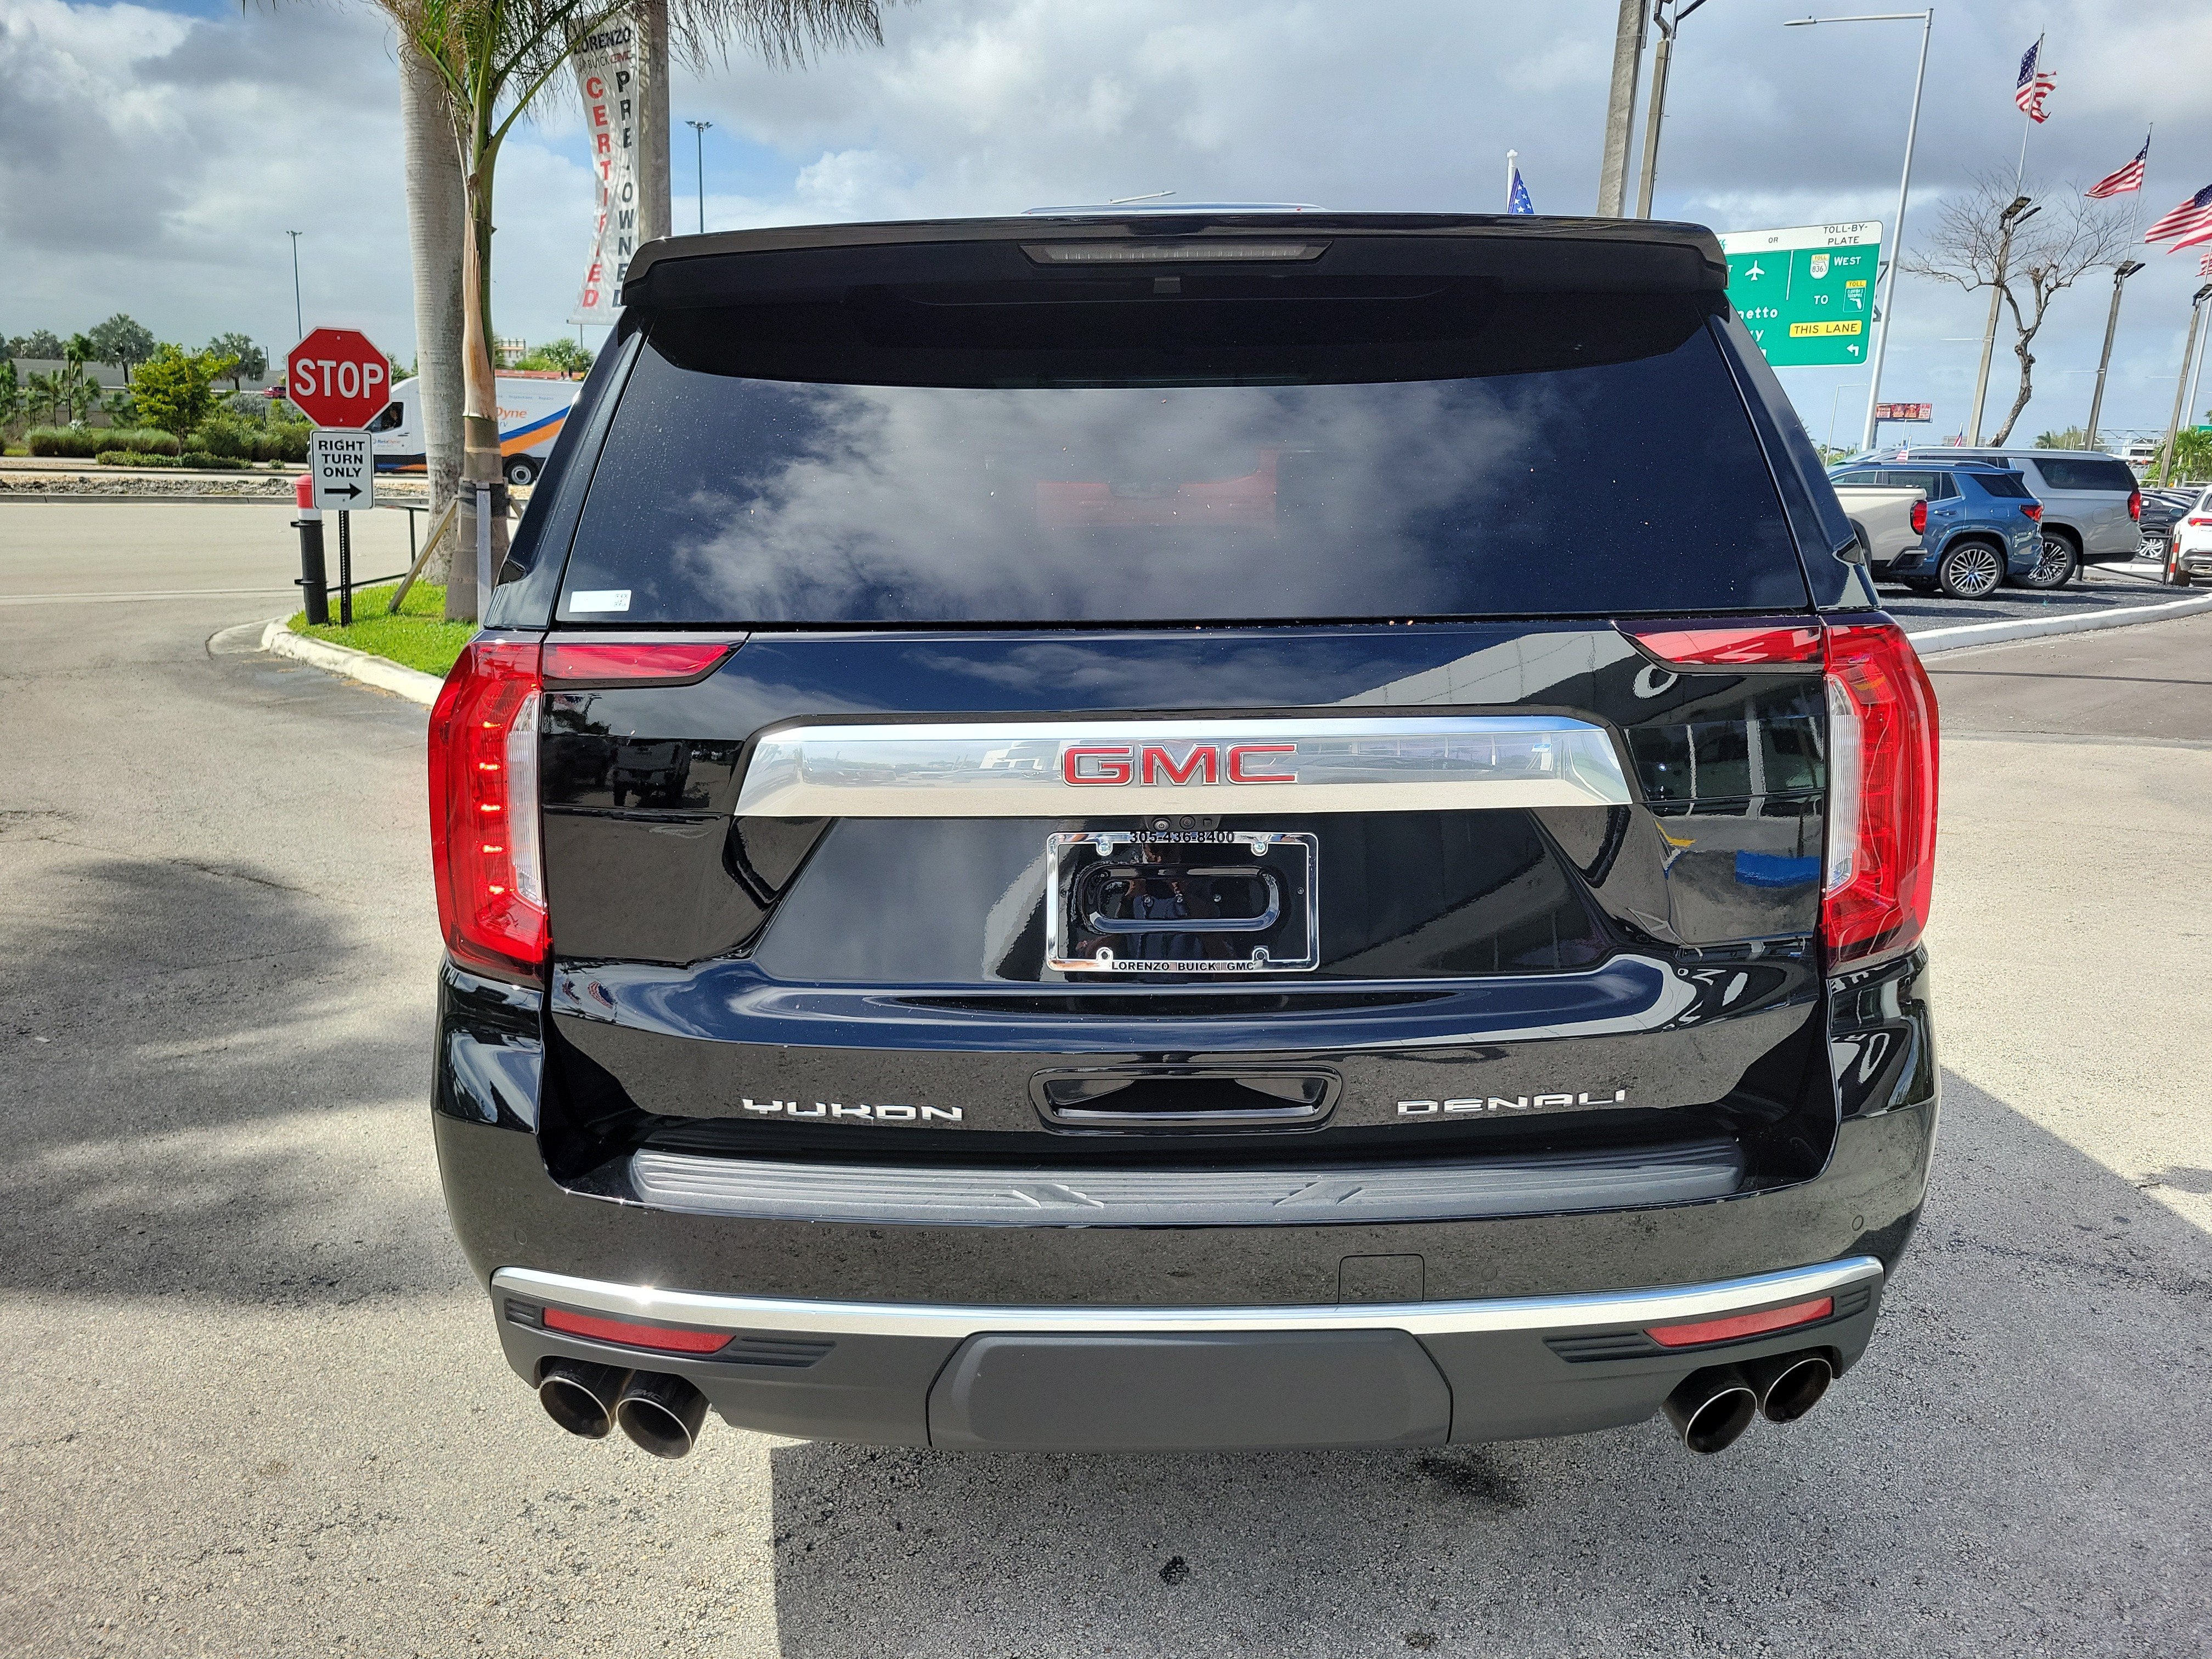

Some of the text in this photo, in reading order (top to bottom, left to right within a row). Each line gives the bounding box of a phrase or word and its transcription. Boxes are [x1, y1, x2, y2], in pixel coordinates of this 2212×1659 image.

[588, 56, 610, 69] BUICK
[1824, 224, 1867, 234] TOLL-BY-
[1827, 236, 1860, 245] PLATE
[1834, 256, 1861, 266] WEST
[1814, 295, 1829, 305] TO
[1795, 324, 1858, 334] THIS LANE
[295, 358, 384, 399] STOP
[318, 440, 365, 451] RIGHT
[321, 454, 363, 465] TURN
[323, 467, 362, 478] ONLY
[1062, 741, 1299, 786] GMC
[1129, 831, 1235, 843] 305-436-8400
[1111, 961, 1254, 971] LORENZO BUICK GMC
[1397, 1088, 1625, 1116] DENALI
[742, 1098, 963, 1121] YUKON
[631, 1389, 663, 1402] GMC
